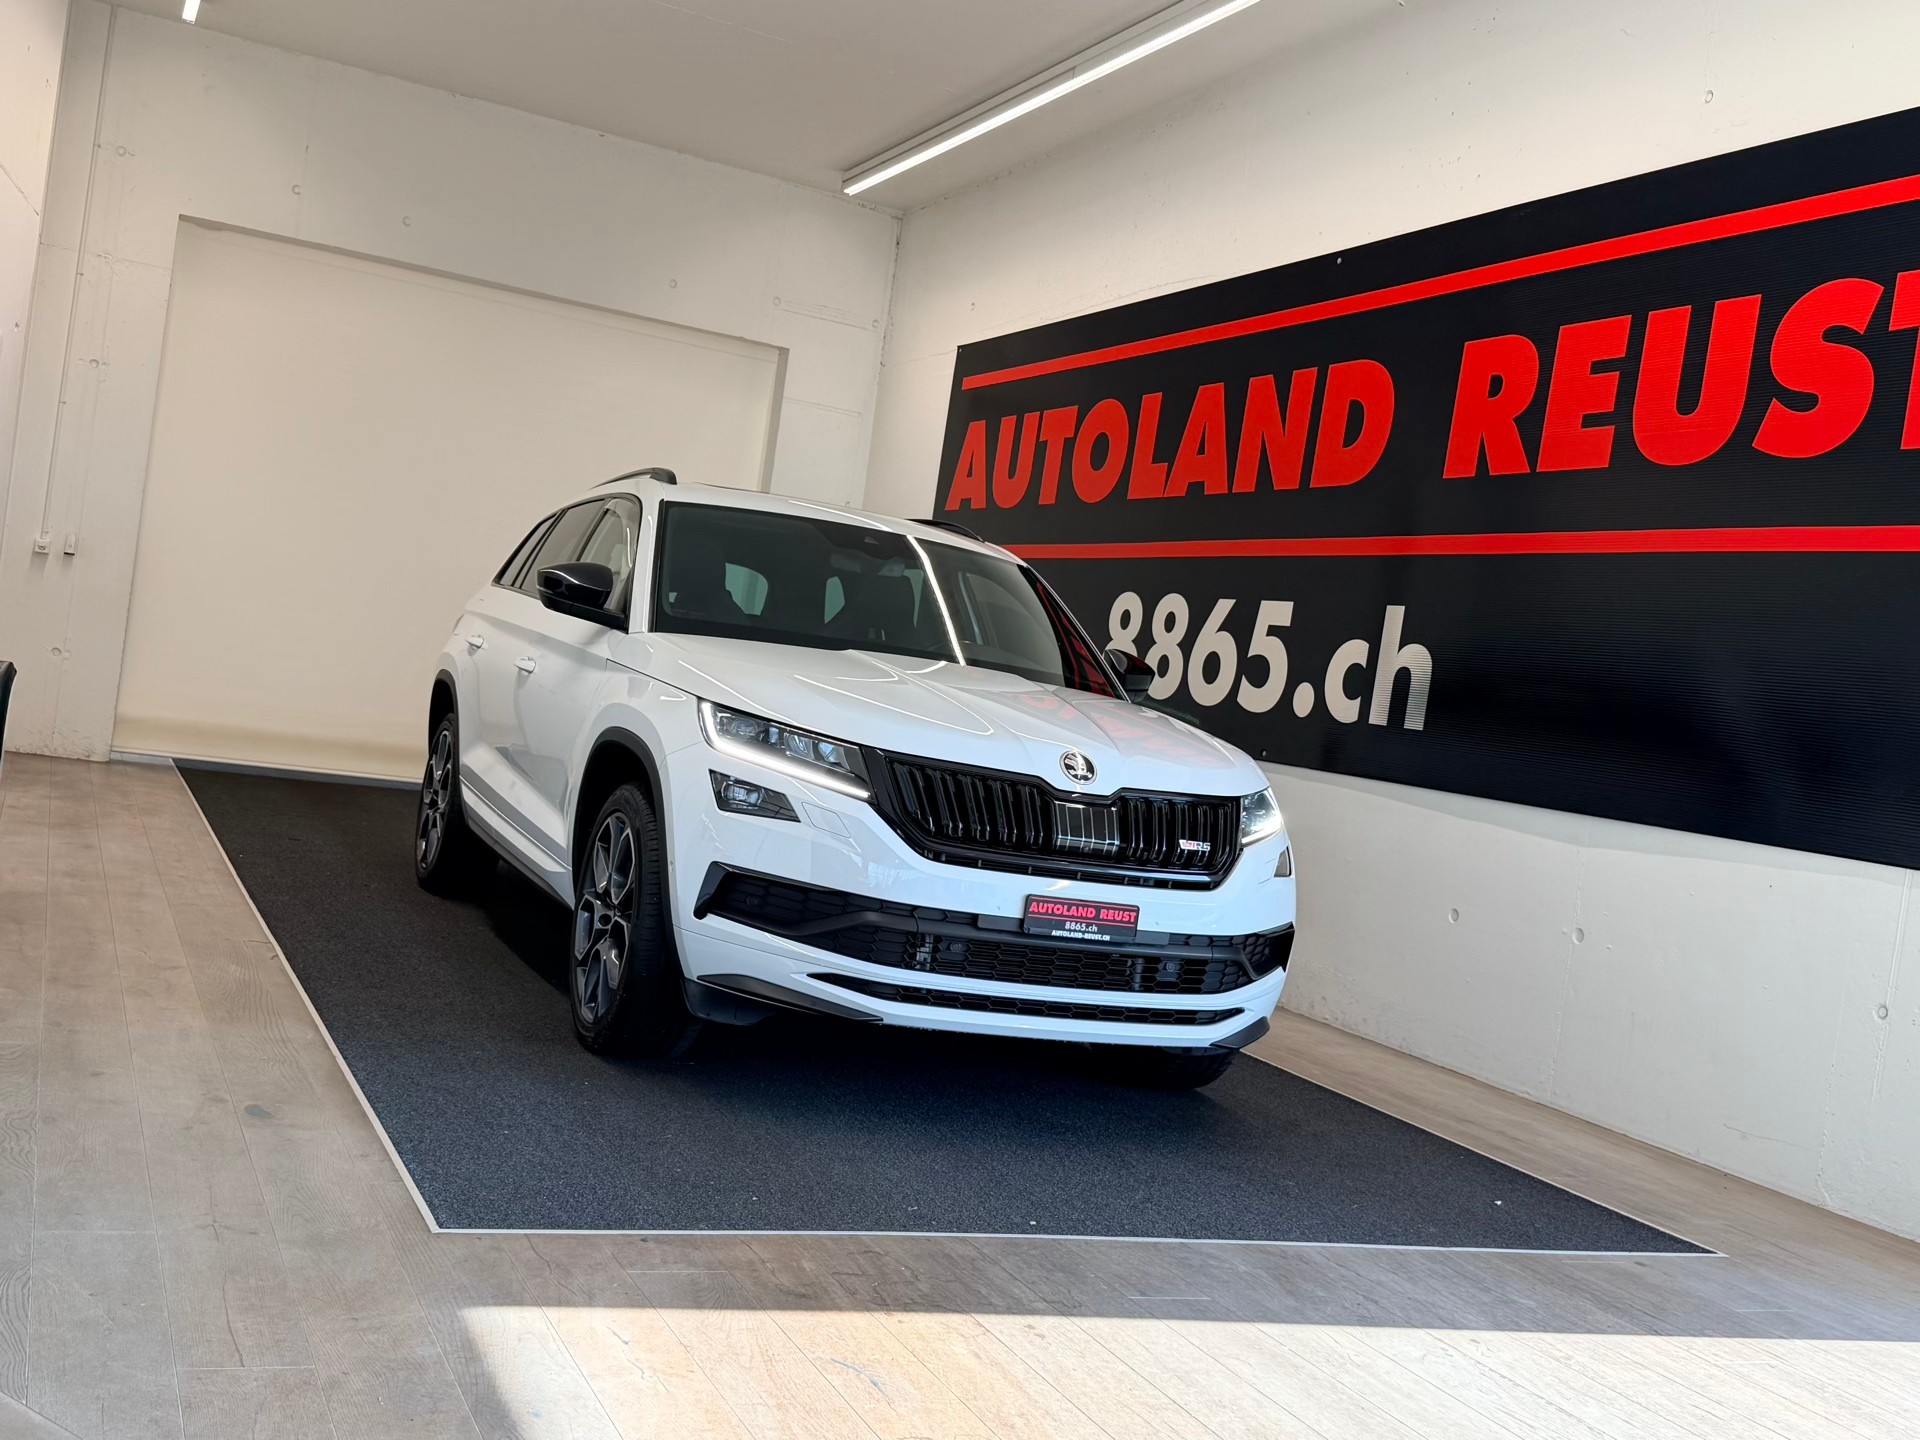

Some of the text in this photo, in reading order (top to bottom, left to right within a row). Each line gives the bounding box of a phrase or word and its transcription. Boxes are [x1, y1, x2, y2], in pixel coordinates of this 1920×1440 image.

[946, 359, 1395, 511] AUTOLAND
[1103, 591, 1433, 731] 8865.ch
[1029, 901, 1137, 922] AUTOLAND REUST
[1051, 929, 1111, 941] AUTOLAND-REUST.CH
[1064, 921, 1098, 932] 8865.ch
